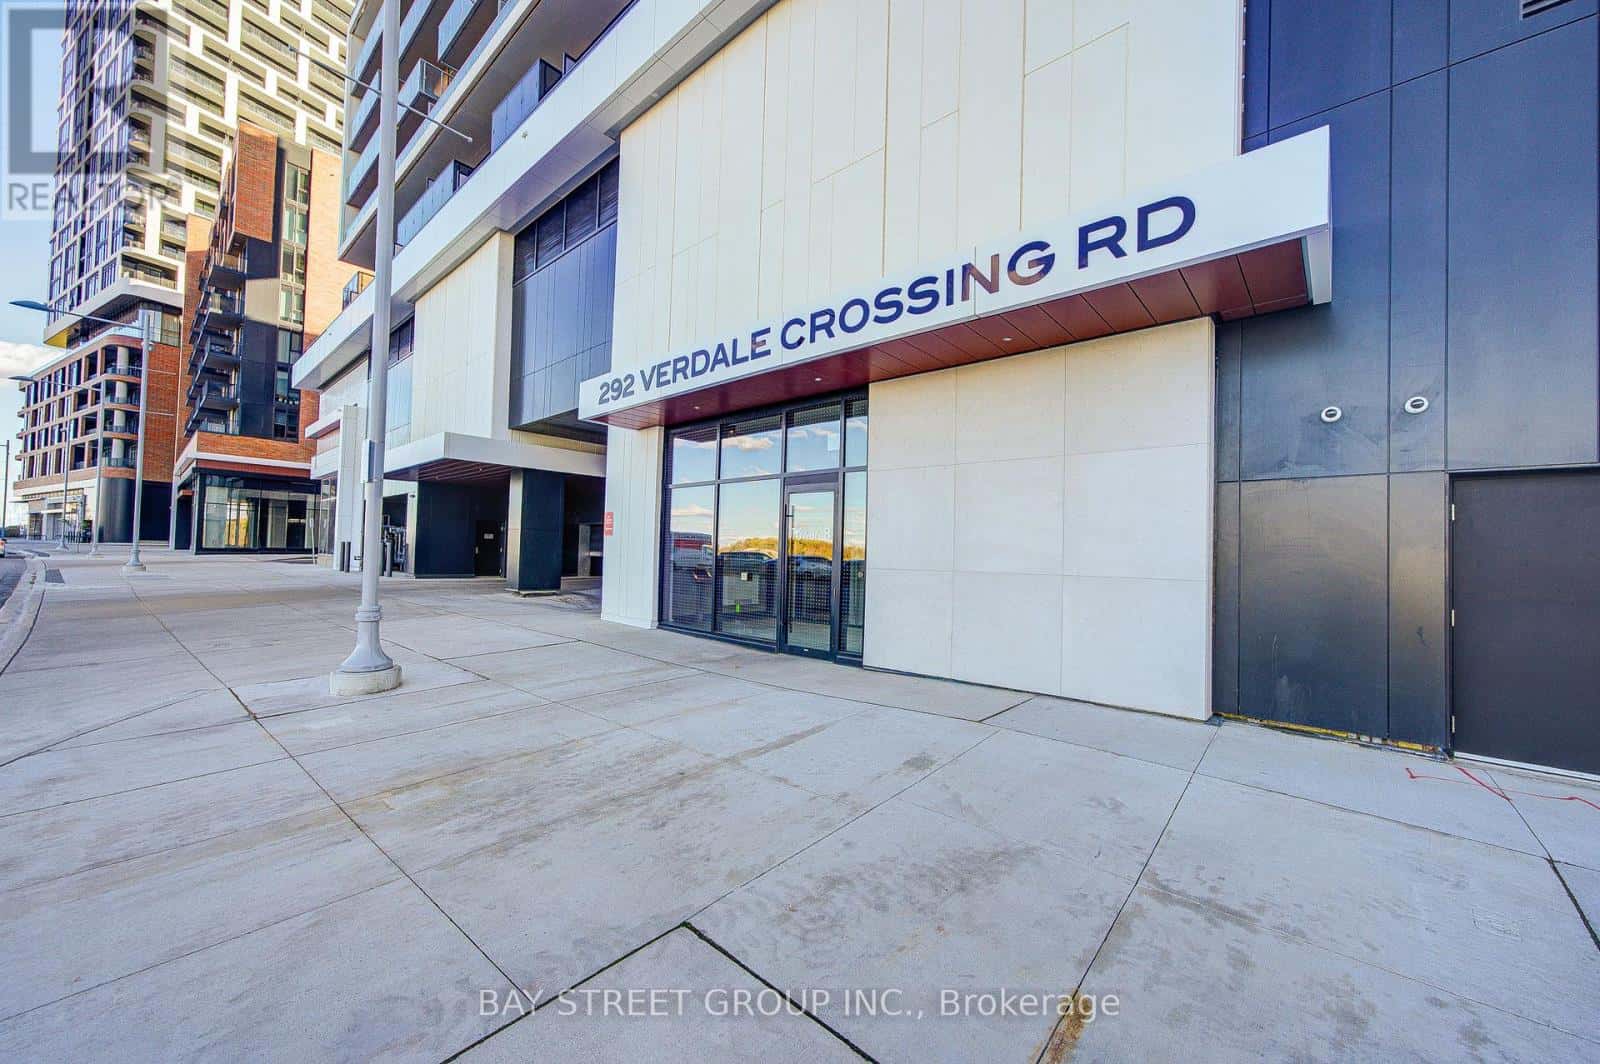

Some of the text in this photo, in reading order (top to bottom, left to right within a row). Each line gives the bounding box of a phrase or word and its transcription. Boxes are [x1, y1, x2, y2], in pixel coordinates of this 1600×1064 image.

[598, 195, 1196, 405] 292 VERDALE CROSSING RD
